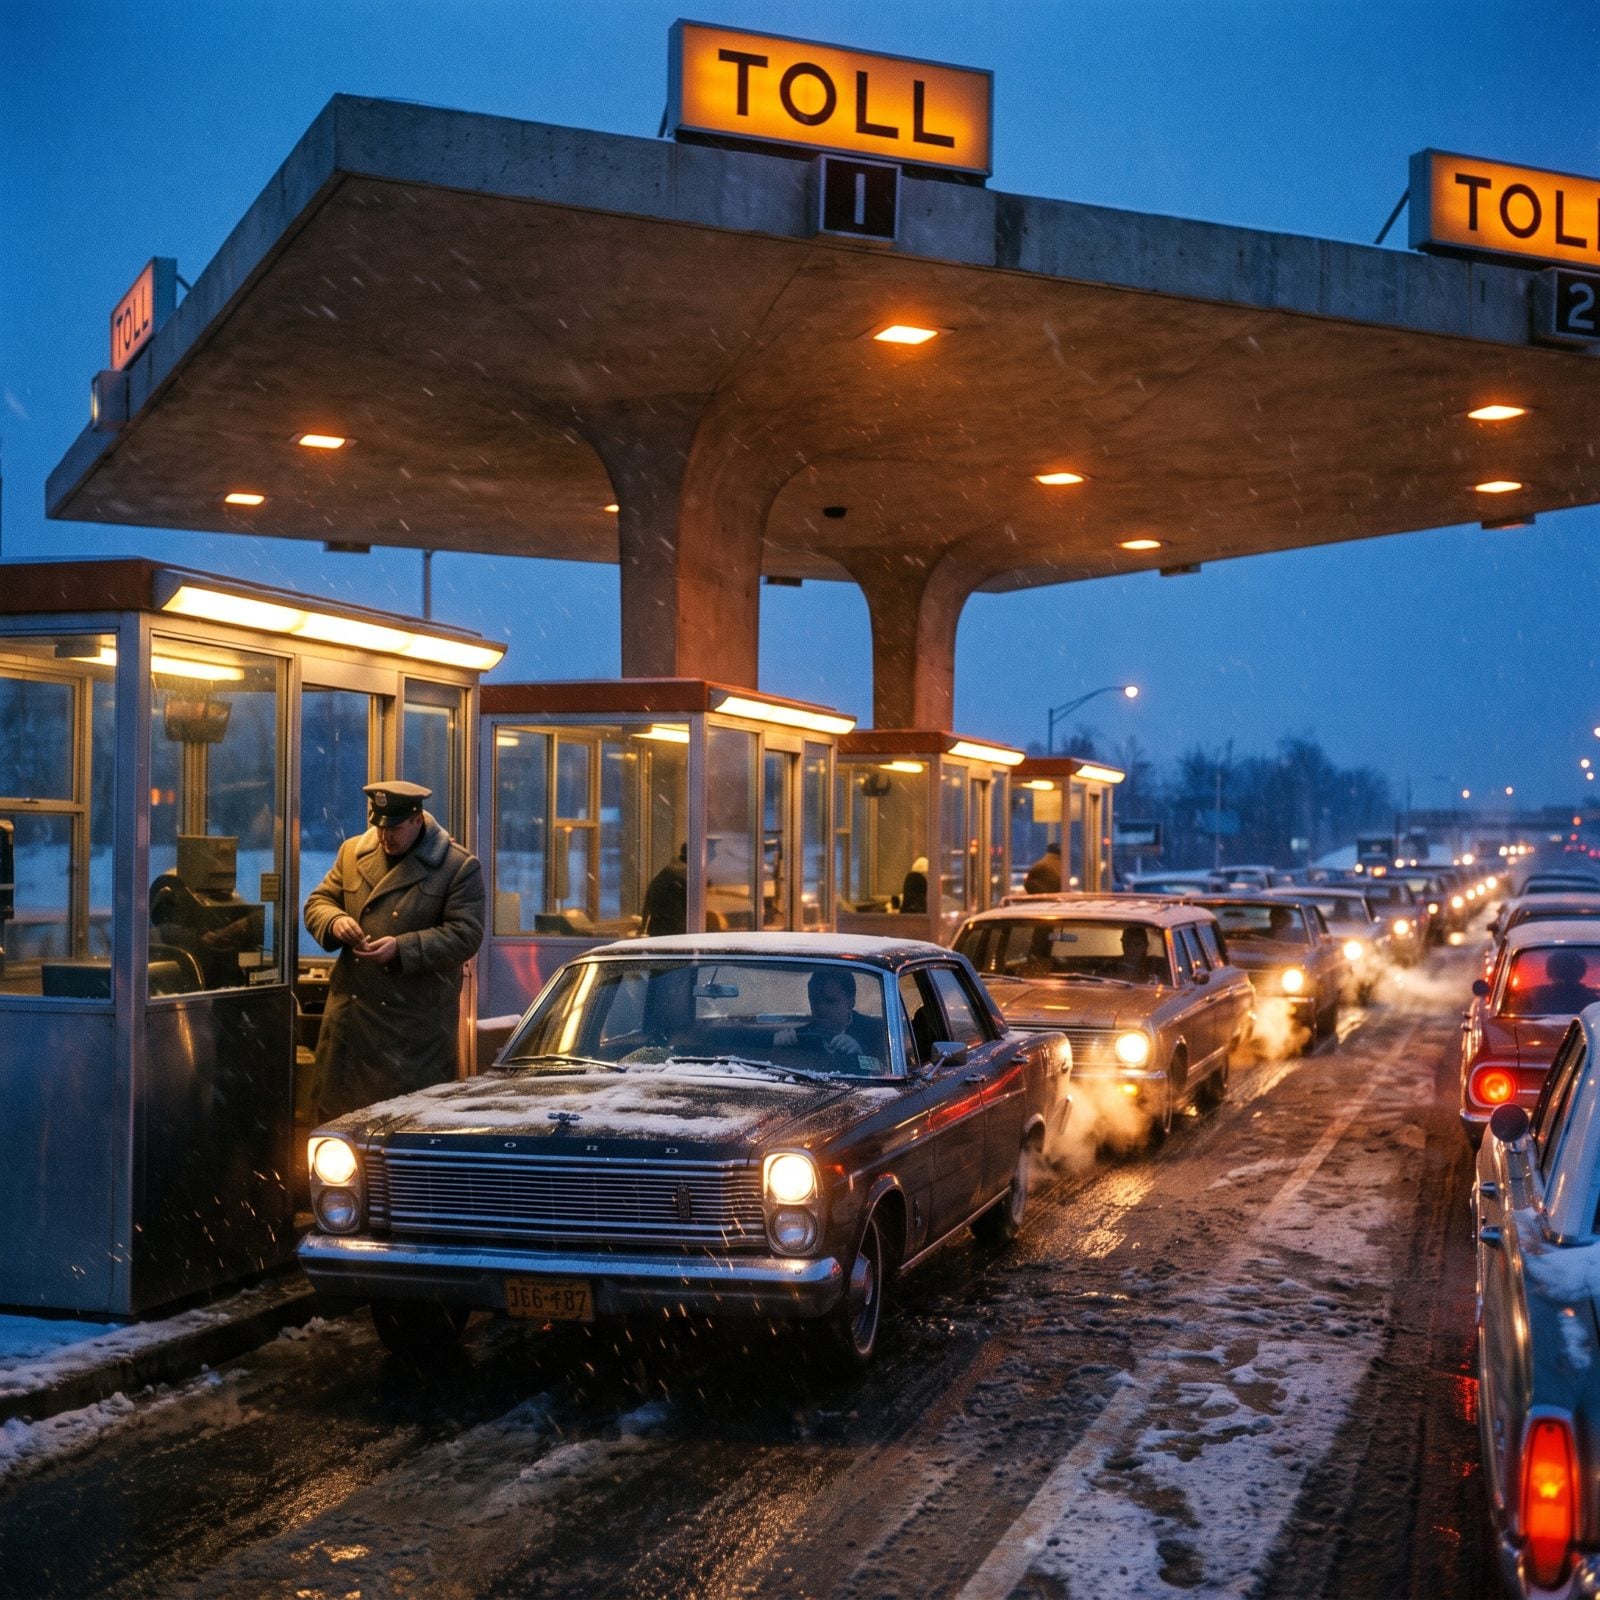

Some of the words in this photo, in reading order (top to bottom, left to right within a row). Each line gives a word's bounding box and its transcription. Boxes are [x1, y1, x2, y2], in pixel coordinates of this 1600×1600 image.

[718, 48, 955, 148] TOLL
[1455, 172, 1600, 252] TOL
[116, 285, 149, 361] TOLL
[1568, 282, 1596, 330] 2
[429, 1138, 679, 1154] FORD
